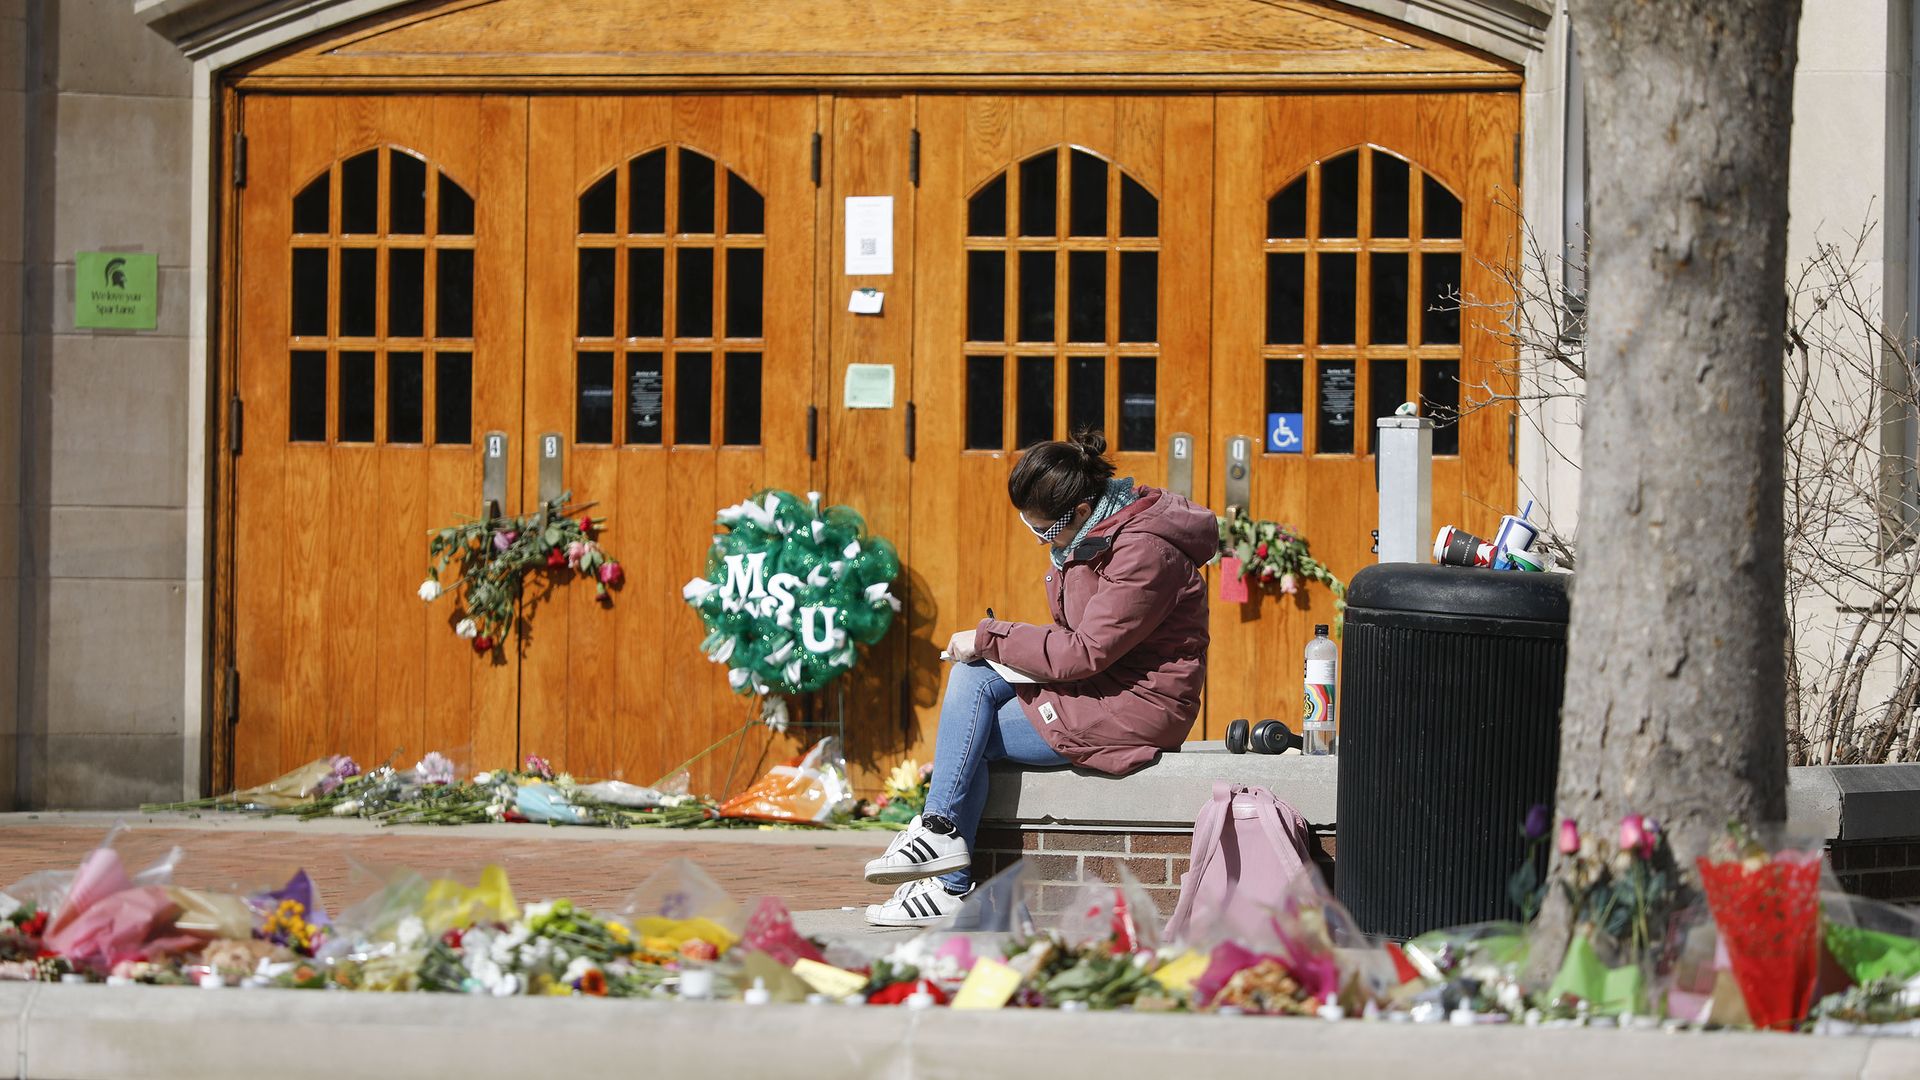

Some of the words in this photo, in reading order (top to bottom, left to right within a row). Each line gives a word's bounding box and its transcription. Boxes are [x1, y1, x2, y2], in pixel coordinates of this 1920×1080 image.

[490, 438, 499, 454] 4
[547, 439, 555, 455] 3
[1175, 439, 1184, 456] 2
[720, 552, 837, 653] MSU
